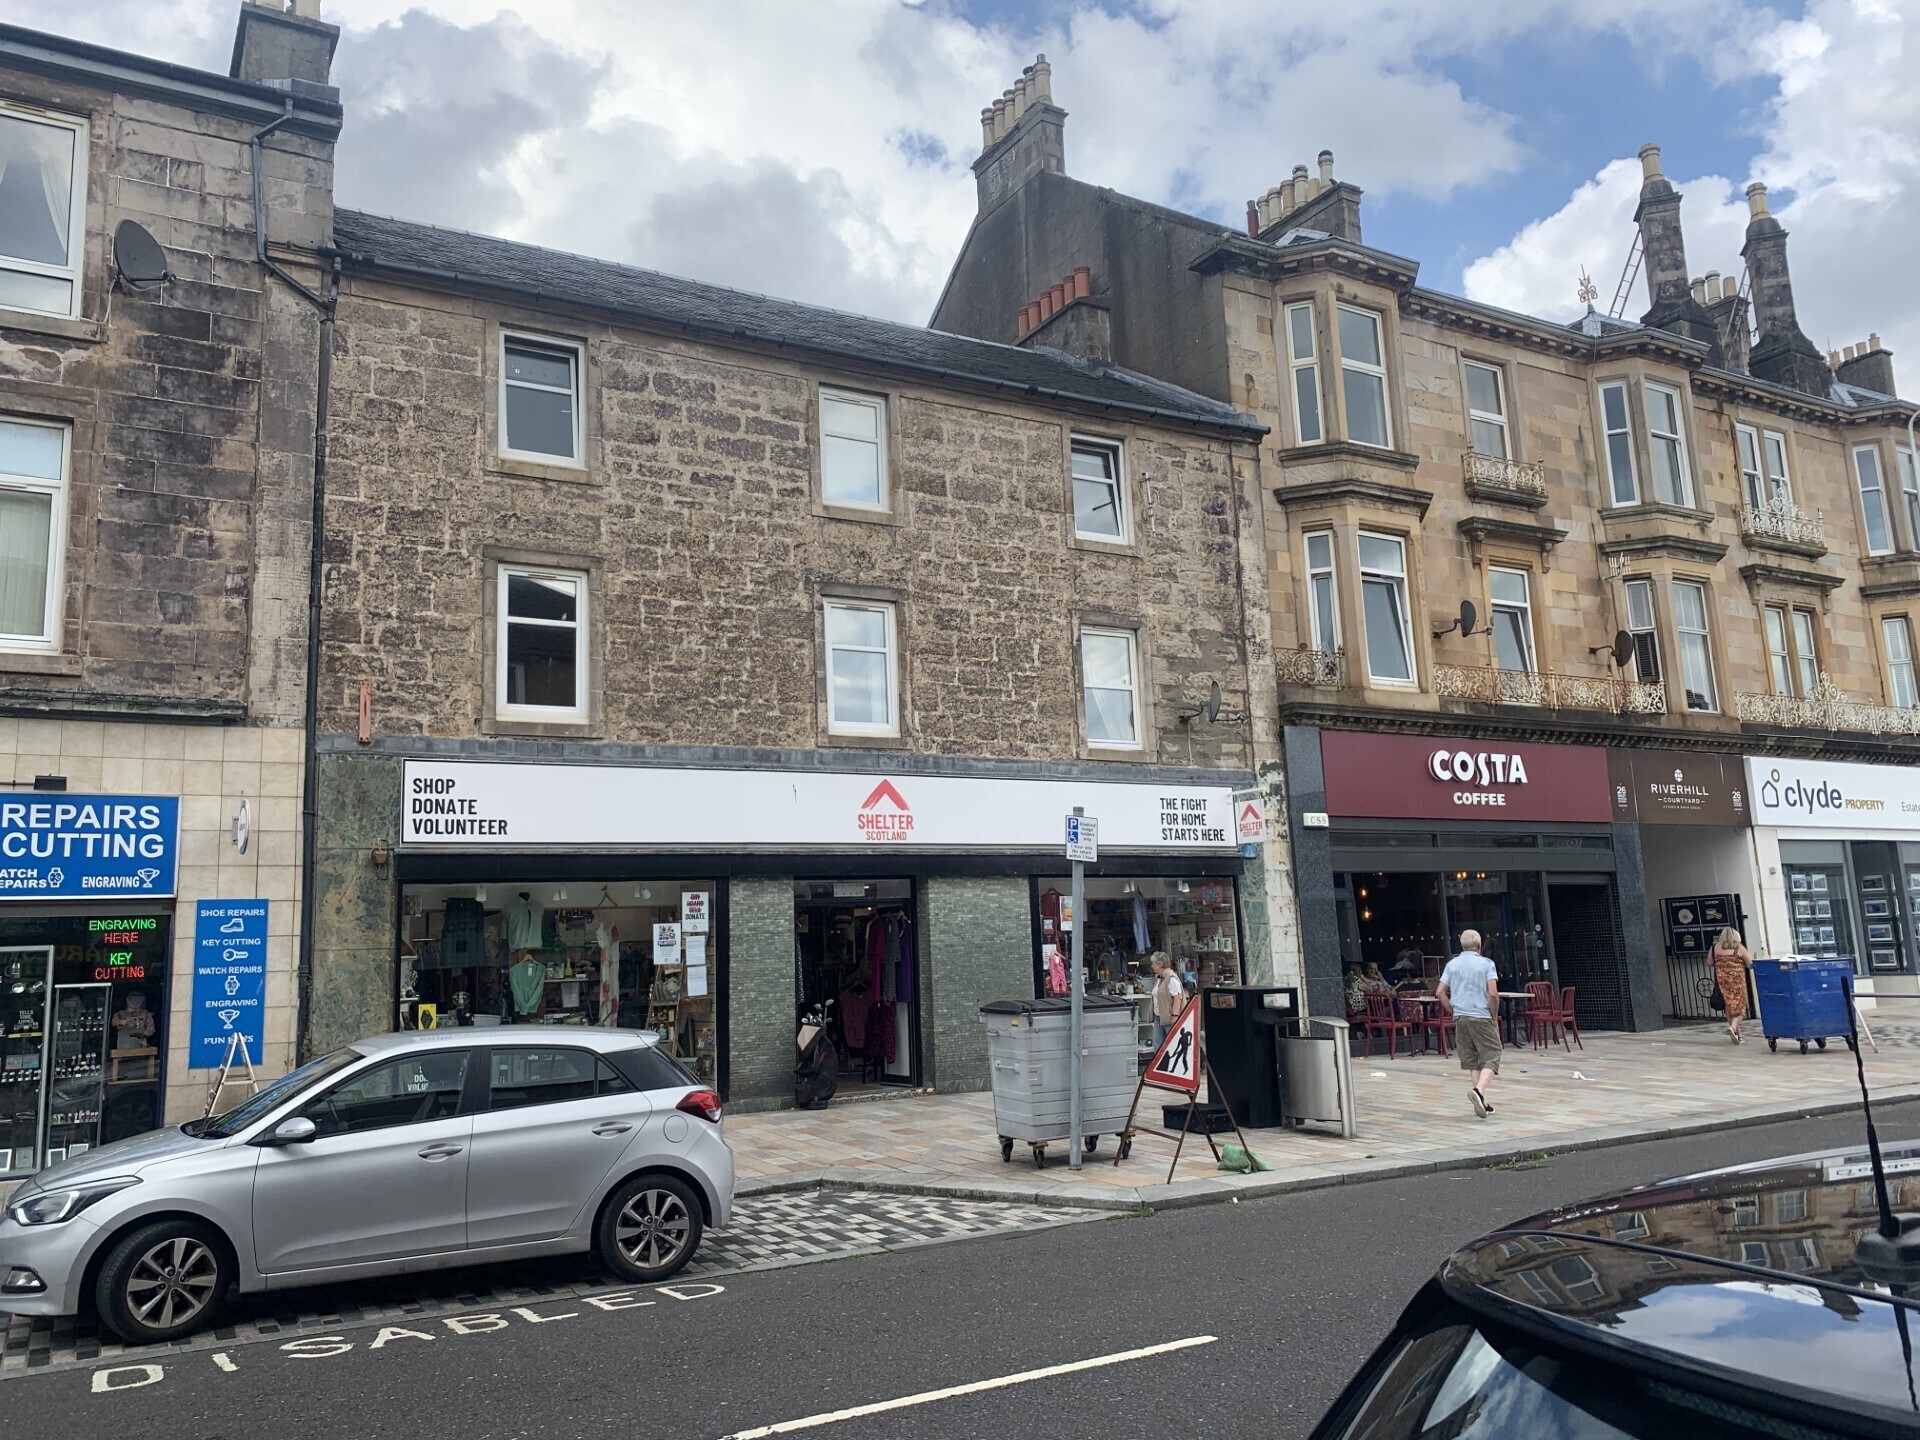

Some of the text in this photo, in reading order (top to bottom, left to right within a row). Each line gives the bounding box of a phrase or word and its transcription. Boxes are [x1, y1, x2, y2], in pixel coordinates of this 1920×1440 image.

[1429, 750, 1528, 787] COSTA
[413, 778, 456, 794] SHOP
[1650, 784, 1709, 796] RIVERHILL
[1453, 792, 1506, 806] COFFEE
[1785, 779, 1884, 814] clyde PROPERTY
[412, 798, 477, 815] DONATE
[1160, 798, 1207, 811] THE FIGHT
[2, 804, 160, 830] REPAIRS
[858, 814, 914, 830] SHELTER
[1161, 812, 1207, 826] FOR HOME
[1310, 816, 1328, 825] CSS
[412, 818, 508, 835] VOLUNTEER
[1071, 819, 1077, 829] P
[1239, 821, 1262, 832] SHELTER
[866, 831, 907, 841] SCOTLAND
[1162, 828, 1225, 841] STARTS HERE
[2, 832, 164, 858] CUTTING
[0, 868, 37, 878] ATCH
[0, 879, 47, 889] EPAIRS
[82, 876, 140, 888] ENGRAVING
[89, 918, 156, 931] ENGRAVING
[104, 932, 138, 944] HERE
[110, 952, 132, 966] KEY
[95, 966, 144, 980] CUTTING
[206, 999, 258, 1008] ENGRAVING
[91, 1283, 727, 1394] DISABLED
